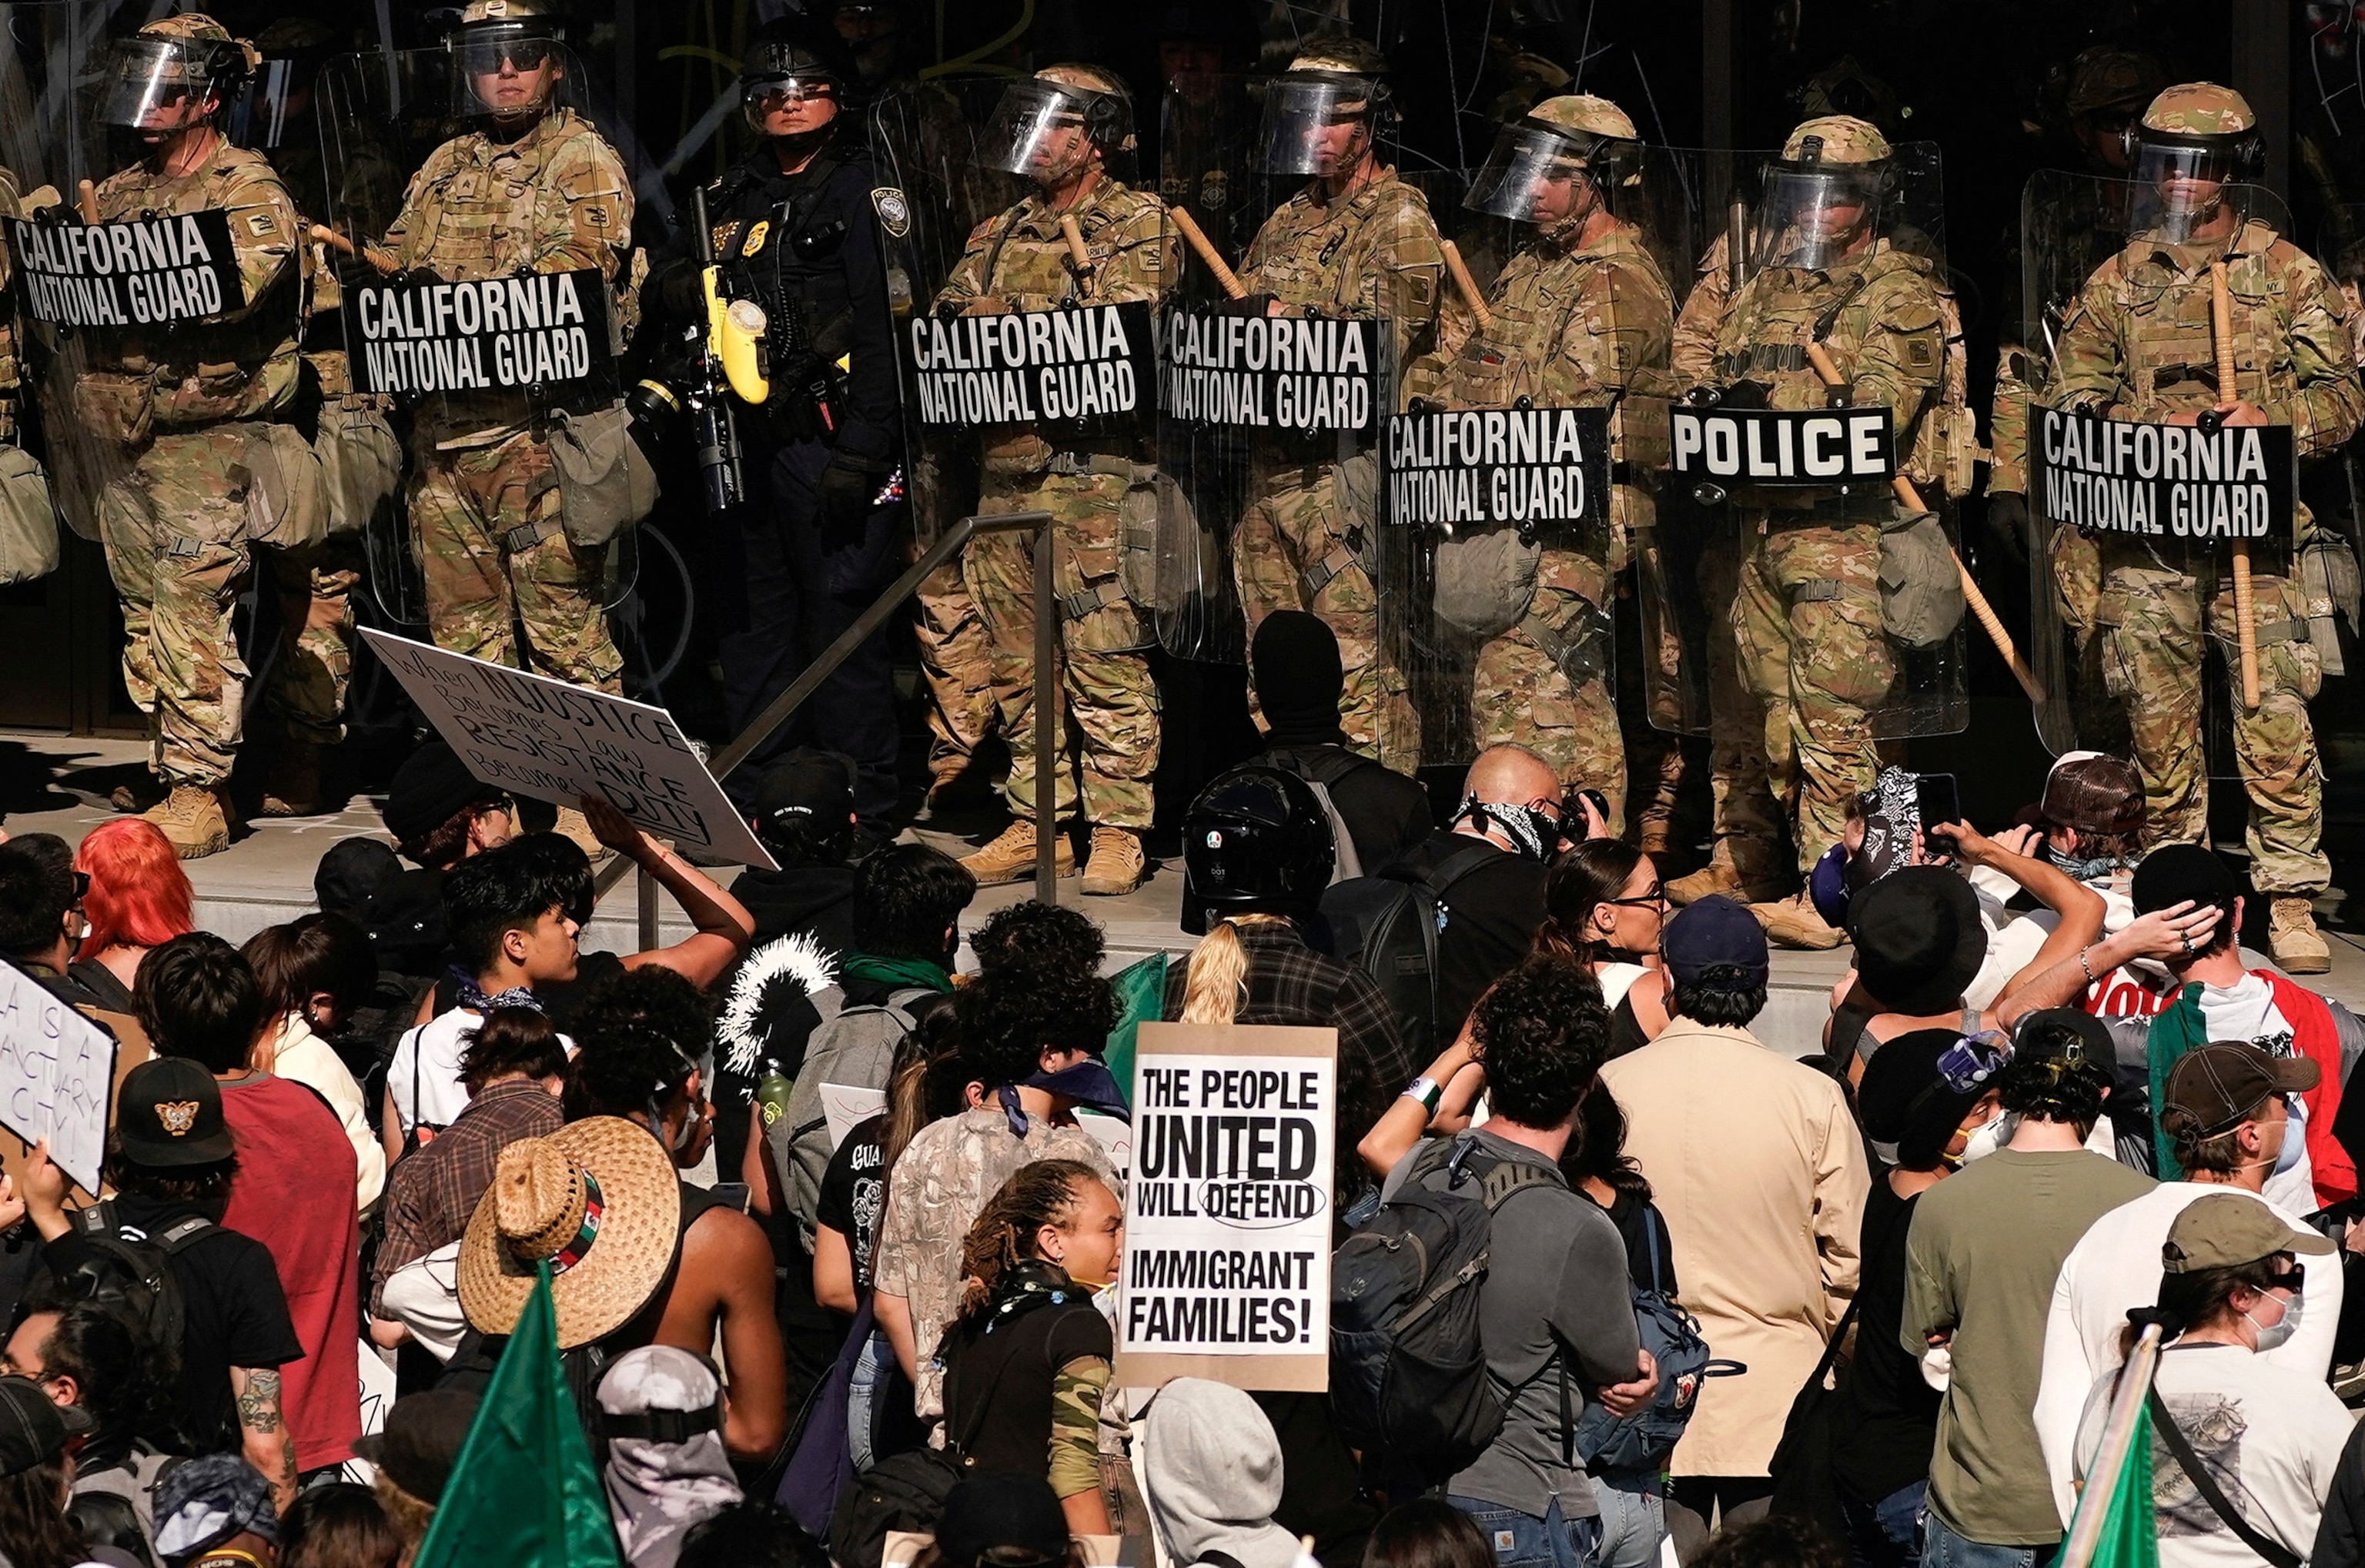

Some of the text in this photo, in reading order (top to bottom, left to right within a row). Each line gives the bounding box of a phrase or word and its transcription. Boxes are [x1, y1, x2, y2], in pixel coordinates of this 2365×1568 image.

[15, 215, 212, 275] CALIFORNIA
[26, 265, 222, 326] NATIONAL GUARD
[359, 272, 584, 339] CALIFORNIA
[365, 326, 590, 393] NATIONAL GUARD
[912, 305, 1131, 369] CALIFORNIA
[1171, 311, 1368, 373] CALIFORNIA
[918, 369, 1036, 424] NATIONAL
[1040, 359, 1136, 420] GUARD
[1170, 367, 1369, 429] NATIONAL GUARD
[1389, 410, 1583, 470] CALIFORNIA
[1673, 414, 1886, 476] POLICE
[2044, 410, 2267, 481] CALIFORNIA
[1390, 466, 1584, 525] NATIONAL GUARD
[2046, 466, 2269, 537] NATIONAL GUARD
[371, 638, 694, 754] When INJUSTICE
[433, 684, 644, 770] Becomes Law
[452, 714, 694, 807] RESISTANCE
[466, 749, 711, 845] Becomes DUTY
[0, 981, 90, 1078] A IS A
[0, 1034, 101, 1132] ANCTUARY
[1142, 1068, 1318, 1110] THE PEOPLE
[1139, 1115, 1317, 1182] UNITED
[1137, 1182, 1315, 1221] WILL DEFEND
[1131, 1249, 1315, 1290] IMMIGRANT
[1128, 1296, 1310, 1344] FAMILIES!
